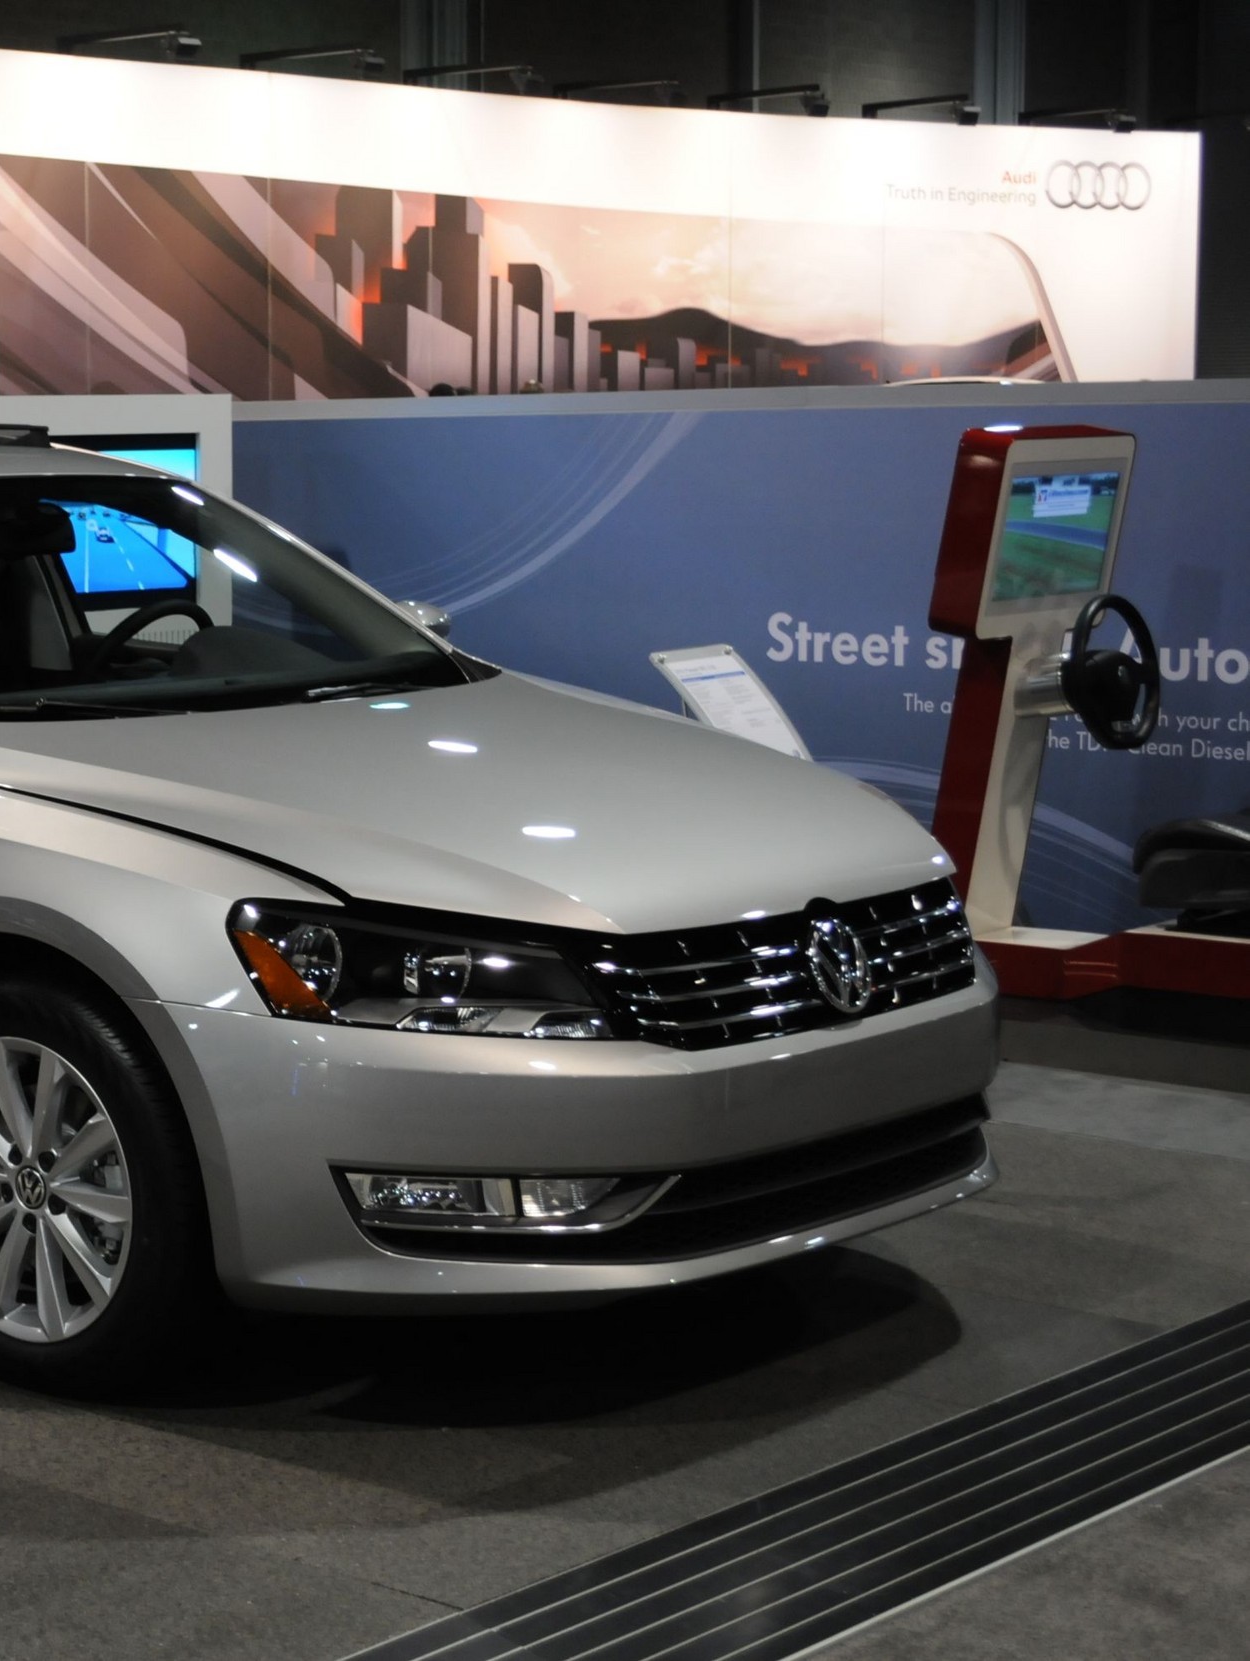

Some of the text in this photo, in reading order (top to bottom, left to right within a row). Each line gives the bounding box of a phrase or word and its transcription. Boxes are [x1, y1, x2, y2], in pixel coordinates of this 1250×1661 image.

[1002, 170, 1037, 185] Audi
[886, 184, 1037, 206] Truth in Engineering
[766, 611, 910, 667] Street
[903, 692, 935, 713] The
[1175, 715, 1222, 733] your
[1191, 738, 1250, 761] Diesel
